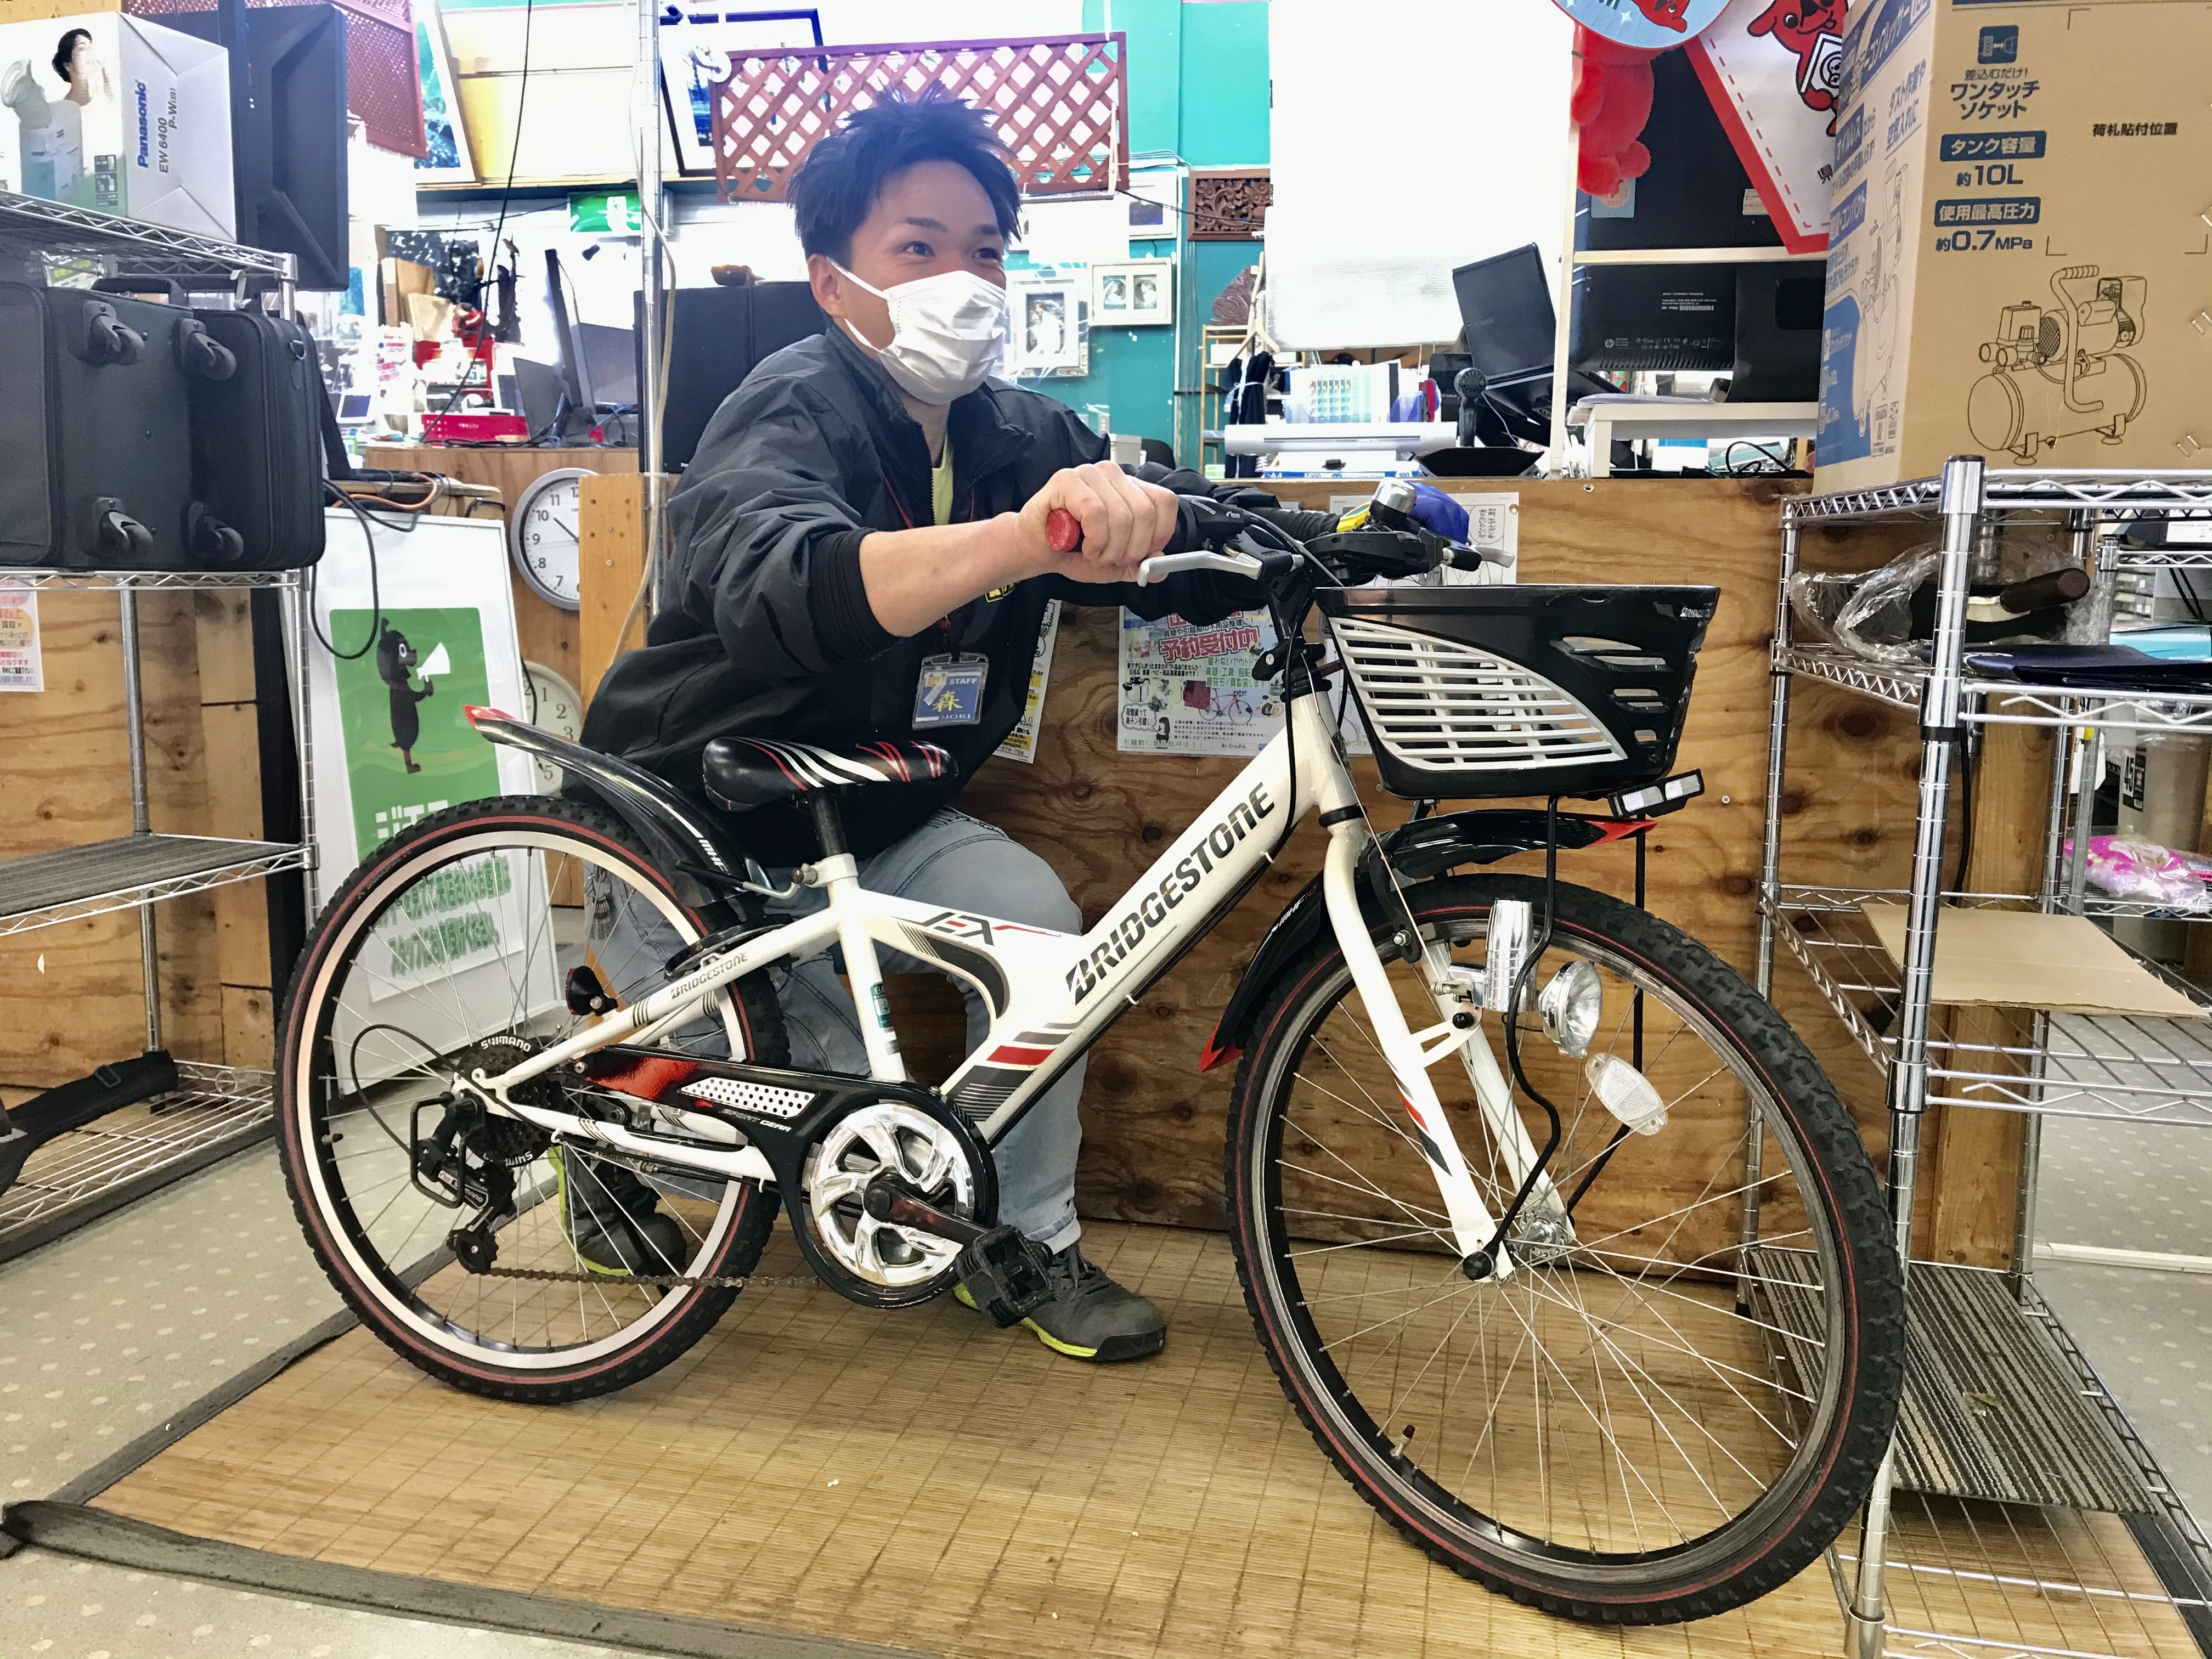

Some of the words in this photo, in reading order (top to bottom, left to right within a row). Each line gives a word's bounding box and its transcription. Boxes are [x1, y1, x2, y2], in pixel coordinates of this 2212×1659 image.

[1950, 80, 2041, 101] ワンタッチ
[1960, 99, 2028, 120] ソケット
[136, 82, 149, 168] Panasonic
[157, 116, 168, 149] 6400
[2092, 121, 2178, 137] 荷札貼付位置
[159, 149, 169, 173] EW
[1955, 164, 2024, 187] 約10L
[1938, 202, 2041, 223] 使用最高圧力
[1935, 229, 2033, 252] 約0.7MPa
[549, 494, 561, 506] 11
[1190, 499, 1216, 515] SHIMANO
[536, 509, 550, 522] 10
[532, 533, 541, 545] 9
[538, 557, 547, 569] 8
[556, 575, 564, 587] 7
[1159, 627, 1260, 663] 予約受付中
[541, 687, 548, 702] 1
[932, 690, 963, 713] 森
[556, 703, 567, 719] 2
[544, 765, 553, 781] 5
[1065, 781, 1276, 1006] BRIDGESTONE
[670, 952, 748, 995] BRIDGESTONE
[481, 1036, 531, 1052] SHIMANO
[759, 1120, 792, 1132] GEAR
